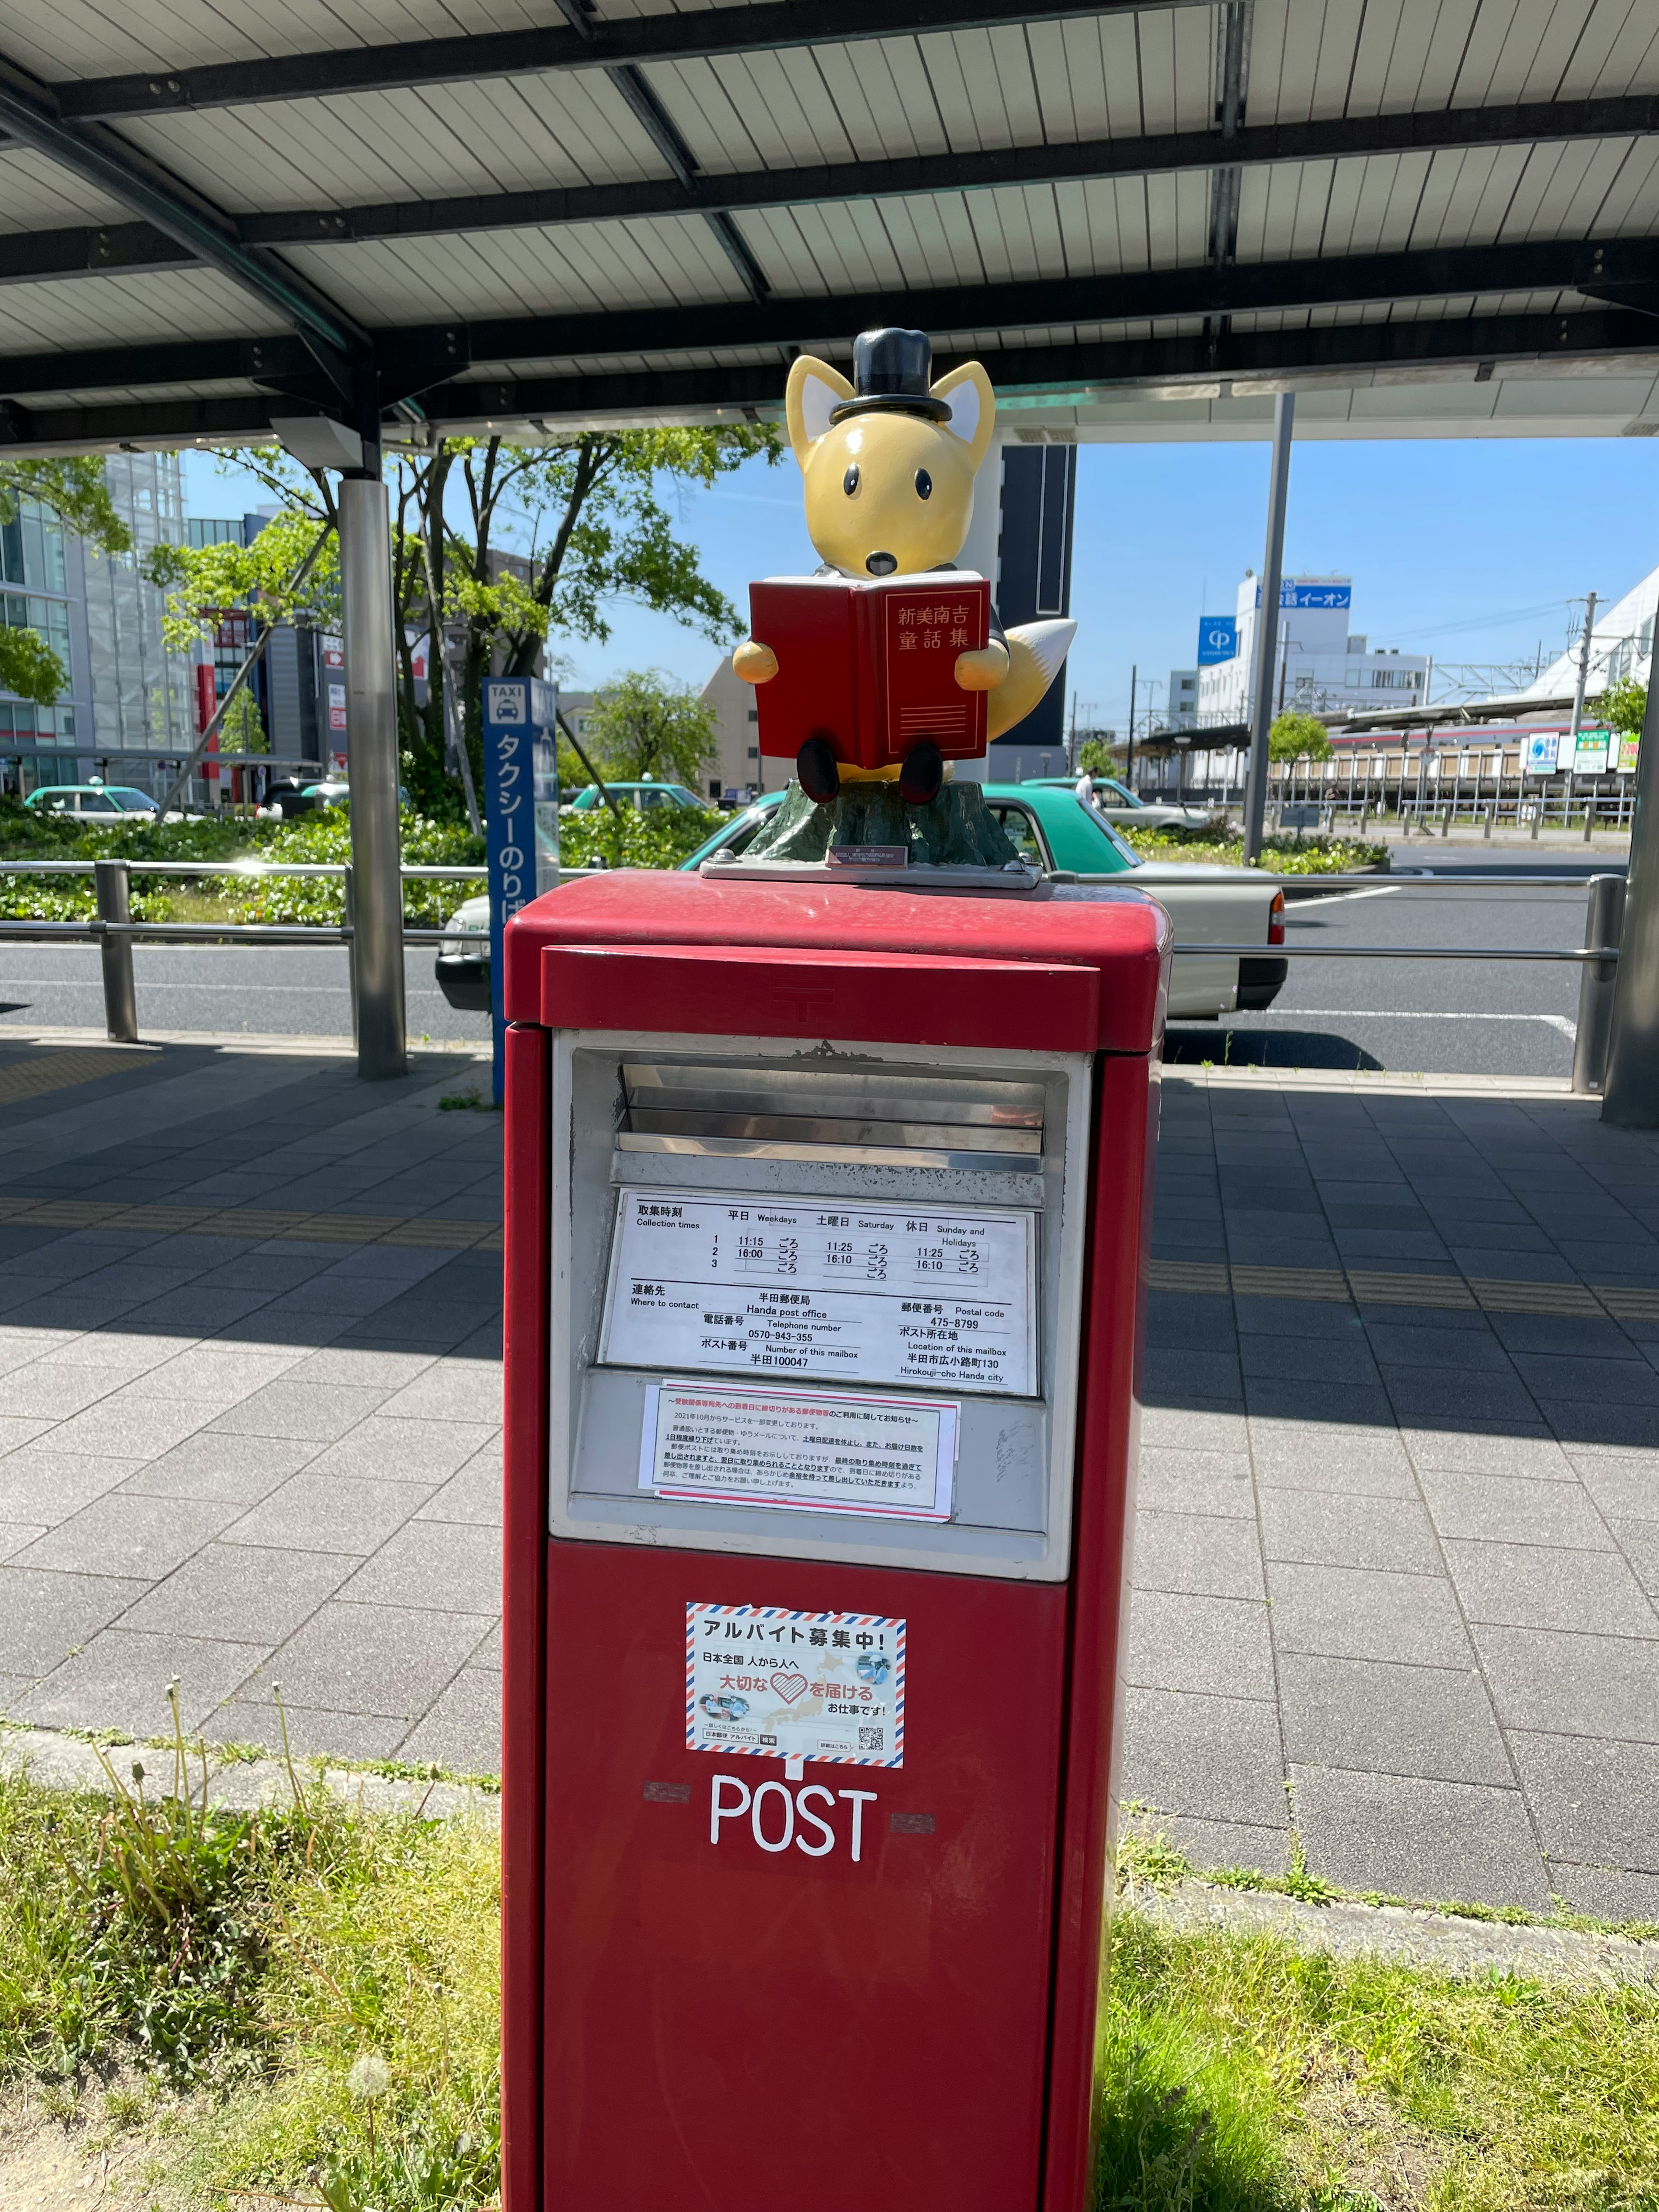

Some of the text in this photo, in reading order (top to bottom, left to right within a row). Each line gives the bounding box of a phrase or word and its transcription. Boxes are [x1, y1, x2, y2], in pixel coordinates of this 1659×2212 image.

[898, 605, 969, 626] 新美南吉
[899, 628, 969, 650] 童話集
[492, 687, 521, 697] TAXI
[638, 1205, 683, 1218] 取集時刻
[637, 1219, 676, 1228] Collection
[728, 1210, 749, 1221] 平日
[758, 1214, 797, 1224] Weekdays
[816, 1215, 849, 1227] 土曜日
[858, 1220, 894, 1231] Saturday
[906, 1220, 928, 1233] 休日
[937, 1225, 967, 1235] Sunday
[714, 1235, 979, 1261] 1 11:15 ごろ 11:25 ごろ 11:25 ごろ
[942, 1237, 976, 1248] Holidays
[712, 1247, 979, 1273] 2 16:00 ごろ 16:10 ごろ 16:10 ごろ
[712, 1259, 887, 1279] 3 ごろ ごろ
[632, 1284, 666, 1297] 連絡先
[631, 1297, 655, 1307] Where
[668, 1301, 699, 1310] contact
[759, 1292, 810, 1306] 半田郵便局
[747, 1304, 827, 1319] Handa post office
[901, 1302, 1004, 1318] 郵便番号 Postal code
[703, 1313, 842, 1333] 電話番号 Telephone number
[930, 1317, 979, 1329] 475-8799
[748, 1329, 813, 1342] 0570-943-355
[899, 1327, 958, 1340] ポスト所在地
[701, 1338, 858, 1359] ポスト番号 Number of this mailbox
[908, 1341, 943, 1351] Location
[957, 1345, 973, 1354] this
[976, 1347, 1007, 1356] mailbox
[750, 1353, 808, 1367] 半田100047
[907, 1353, 999, 1369] 半田市広小路町130
[900, 1366, 1004, 1382] Hirokouji-cho Handa city
[703, 1652, 799, 1669] 日本全国 人から人へ
[720, 1674, 873, 1701] 大切な を届ける
[706, 1731, 776, 1745] 日本郵便 アルバイト 検索
[710, 1774, 878, 1862] POST
